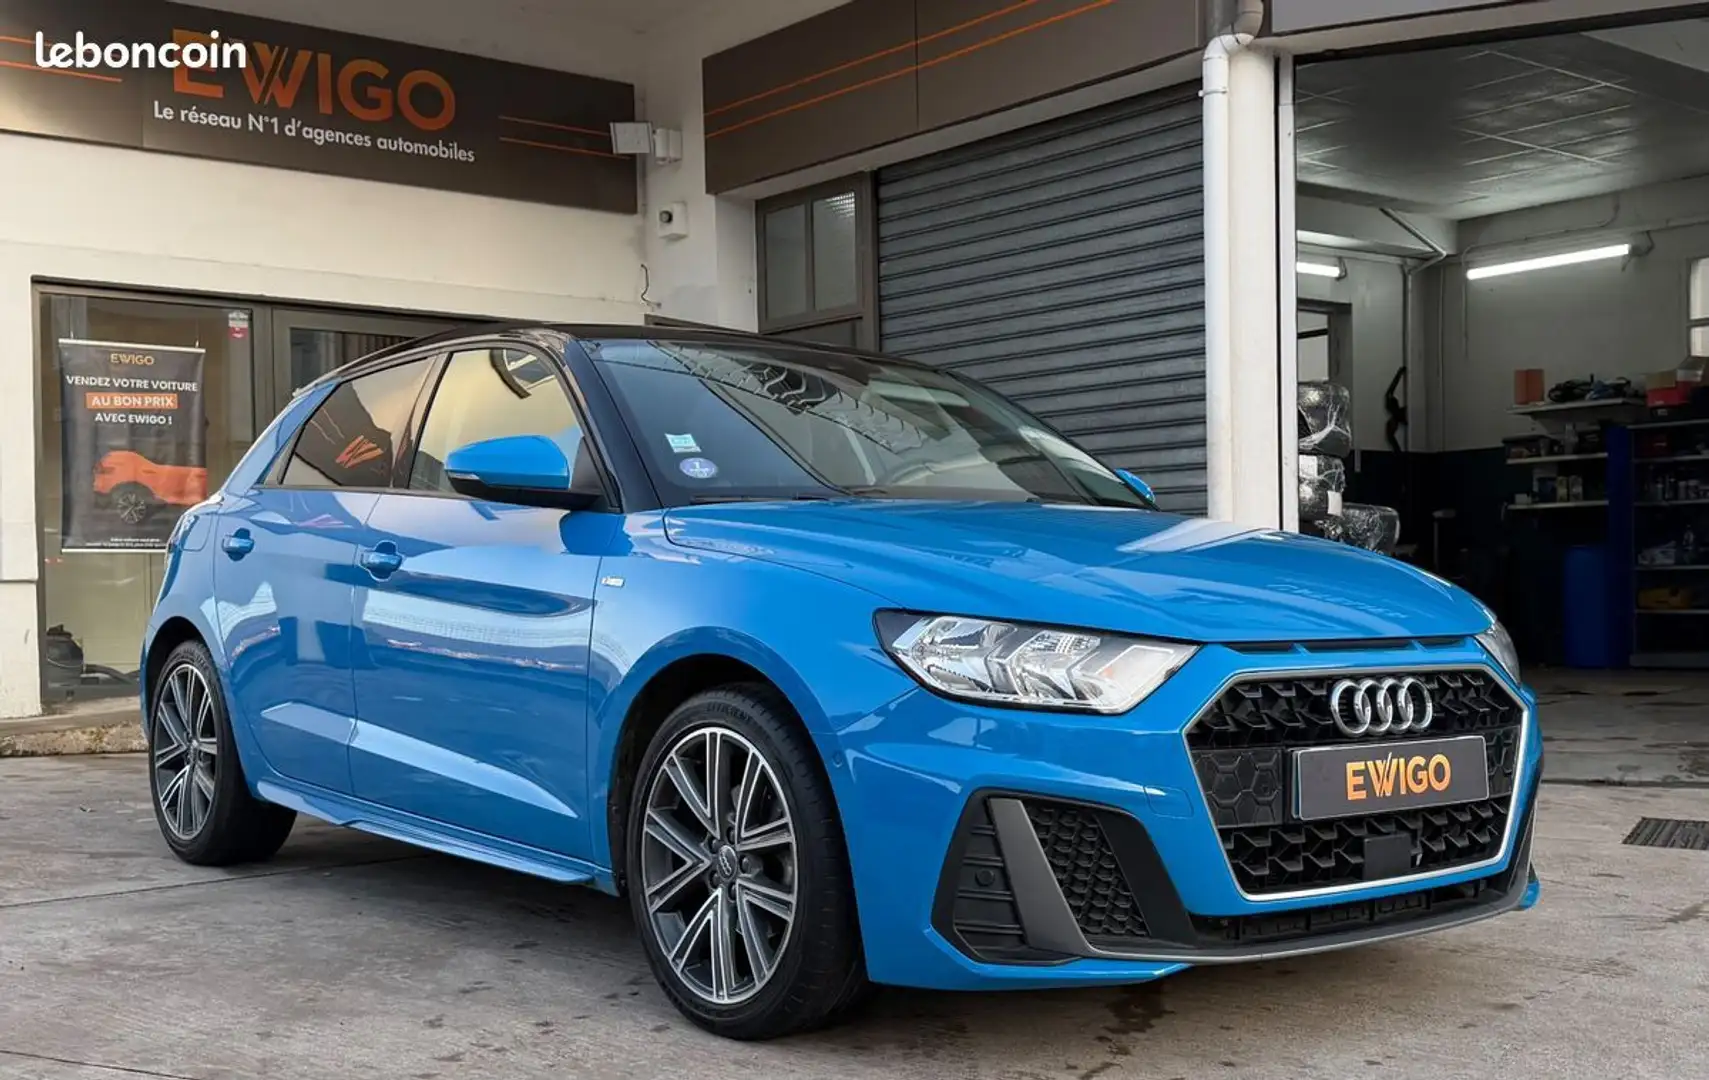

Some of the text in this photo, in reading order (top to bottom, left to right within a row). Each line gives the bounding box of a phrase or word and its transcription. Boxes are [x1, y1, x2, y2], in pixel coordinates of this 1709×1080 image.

[153, 100, 174, 120] Le
[180, 105, 242, 129] réseau
[377, 137, 476, 162] automobiles
[110, 353, 155, 366] EWIGO
[66, 375, 198, 392] VENDEZ VOTRE VOITURE
[92, 396, 175, 408] AU BON PRIX
[95, 413, 127, 424] AVEC
[128, 414, 167, 425] EWIGO
[1346, 751, 1452, 801] EWIGO
